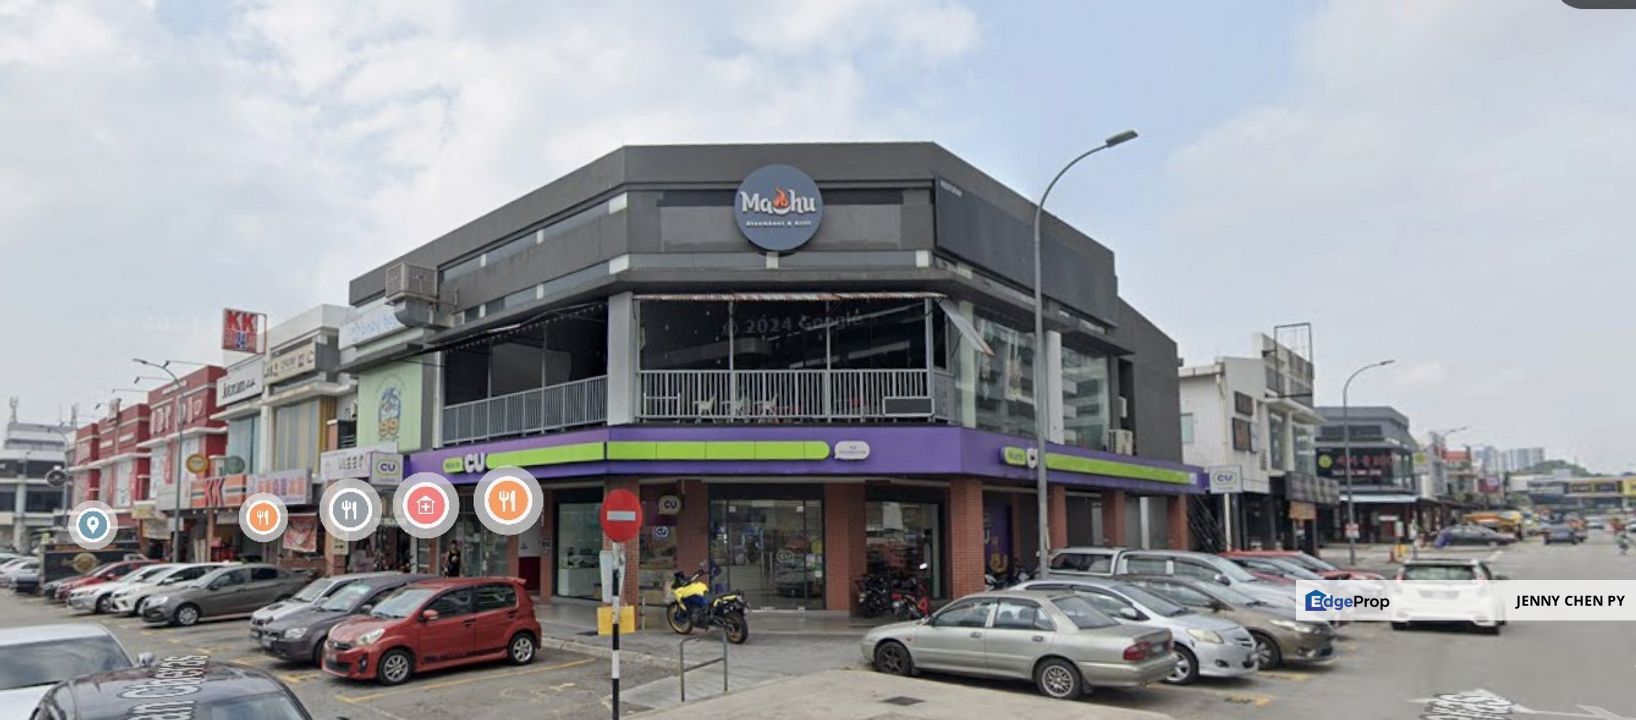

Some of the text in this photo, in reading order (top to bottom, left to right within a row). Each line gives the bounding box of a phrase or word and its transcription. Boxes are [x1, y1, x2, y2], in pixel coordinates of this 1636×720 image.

[226, 311, 256, 333] KK
[379, 463, 396, 472] CU
[464, 451, 485, 473] CU
[1217, 473, 1233, 482] CU
[205, 478, 225, 507] KK
[663, 500, 677, 509] CU
